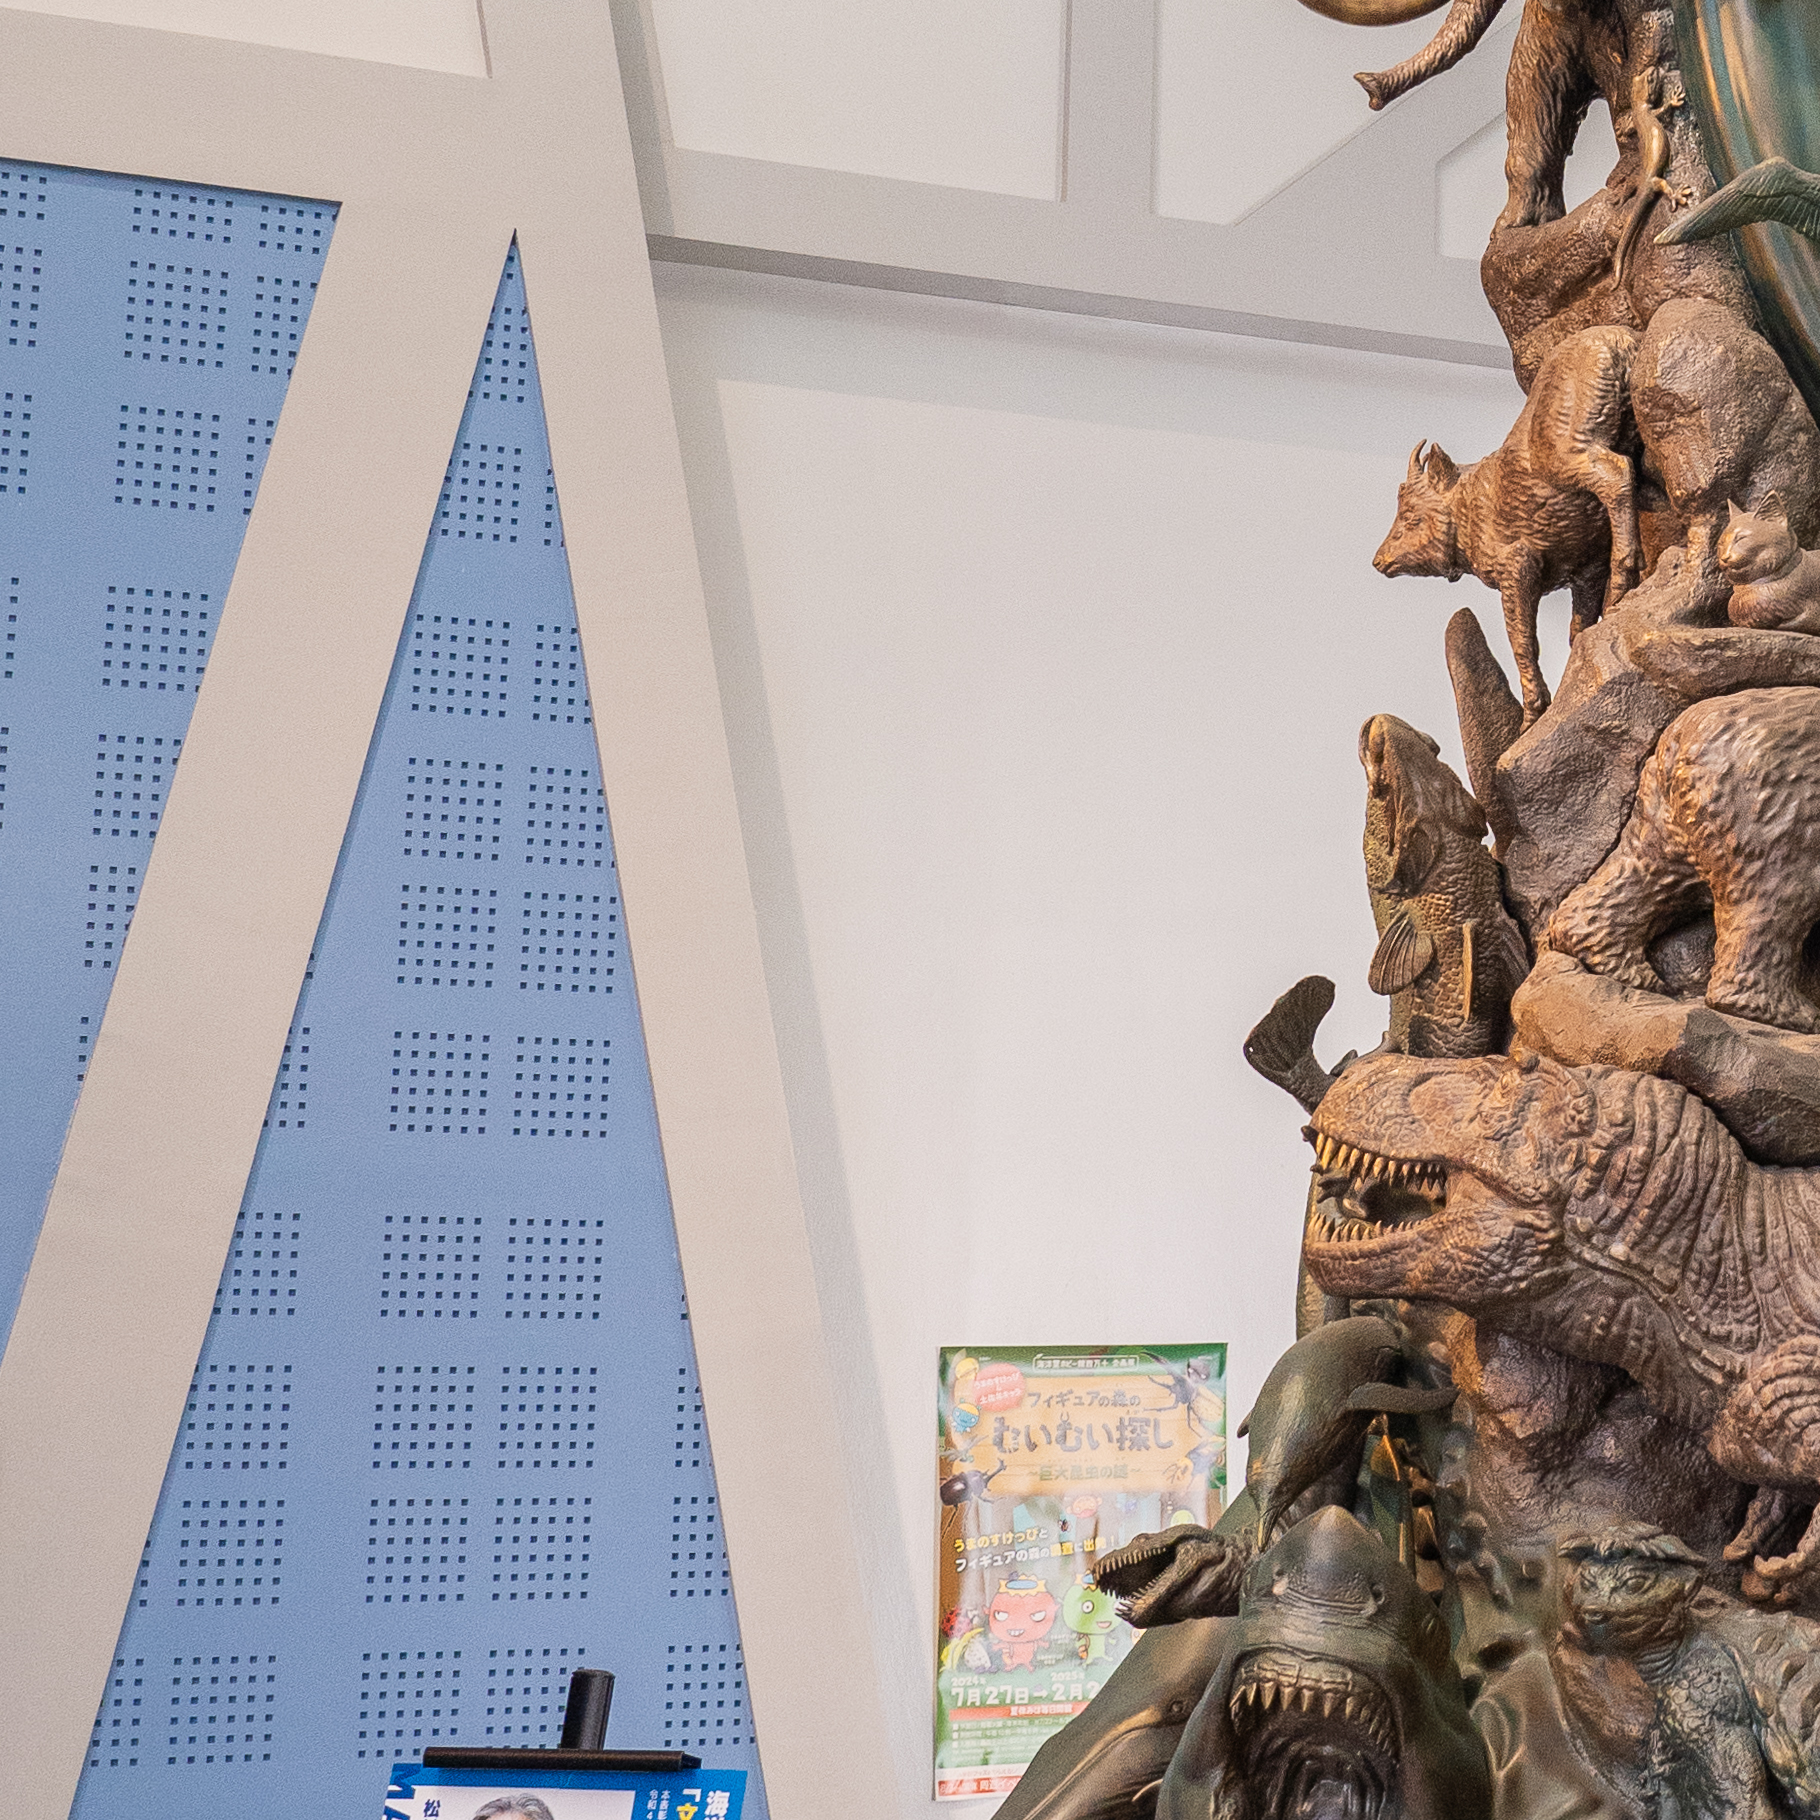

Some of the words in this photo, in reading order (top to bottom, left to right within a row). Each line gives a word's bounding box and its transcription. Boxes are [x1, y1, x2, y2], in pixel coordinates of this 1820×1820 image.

[992, 1416, 1174, 1454] むいむい探し
